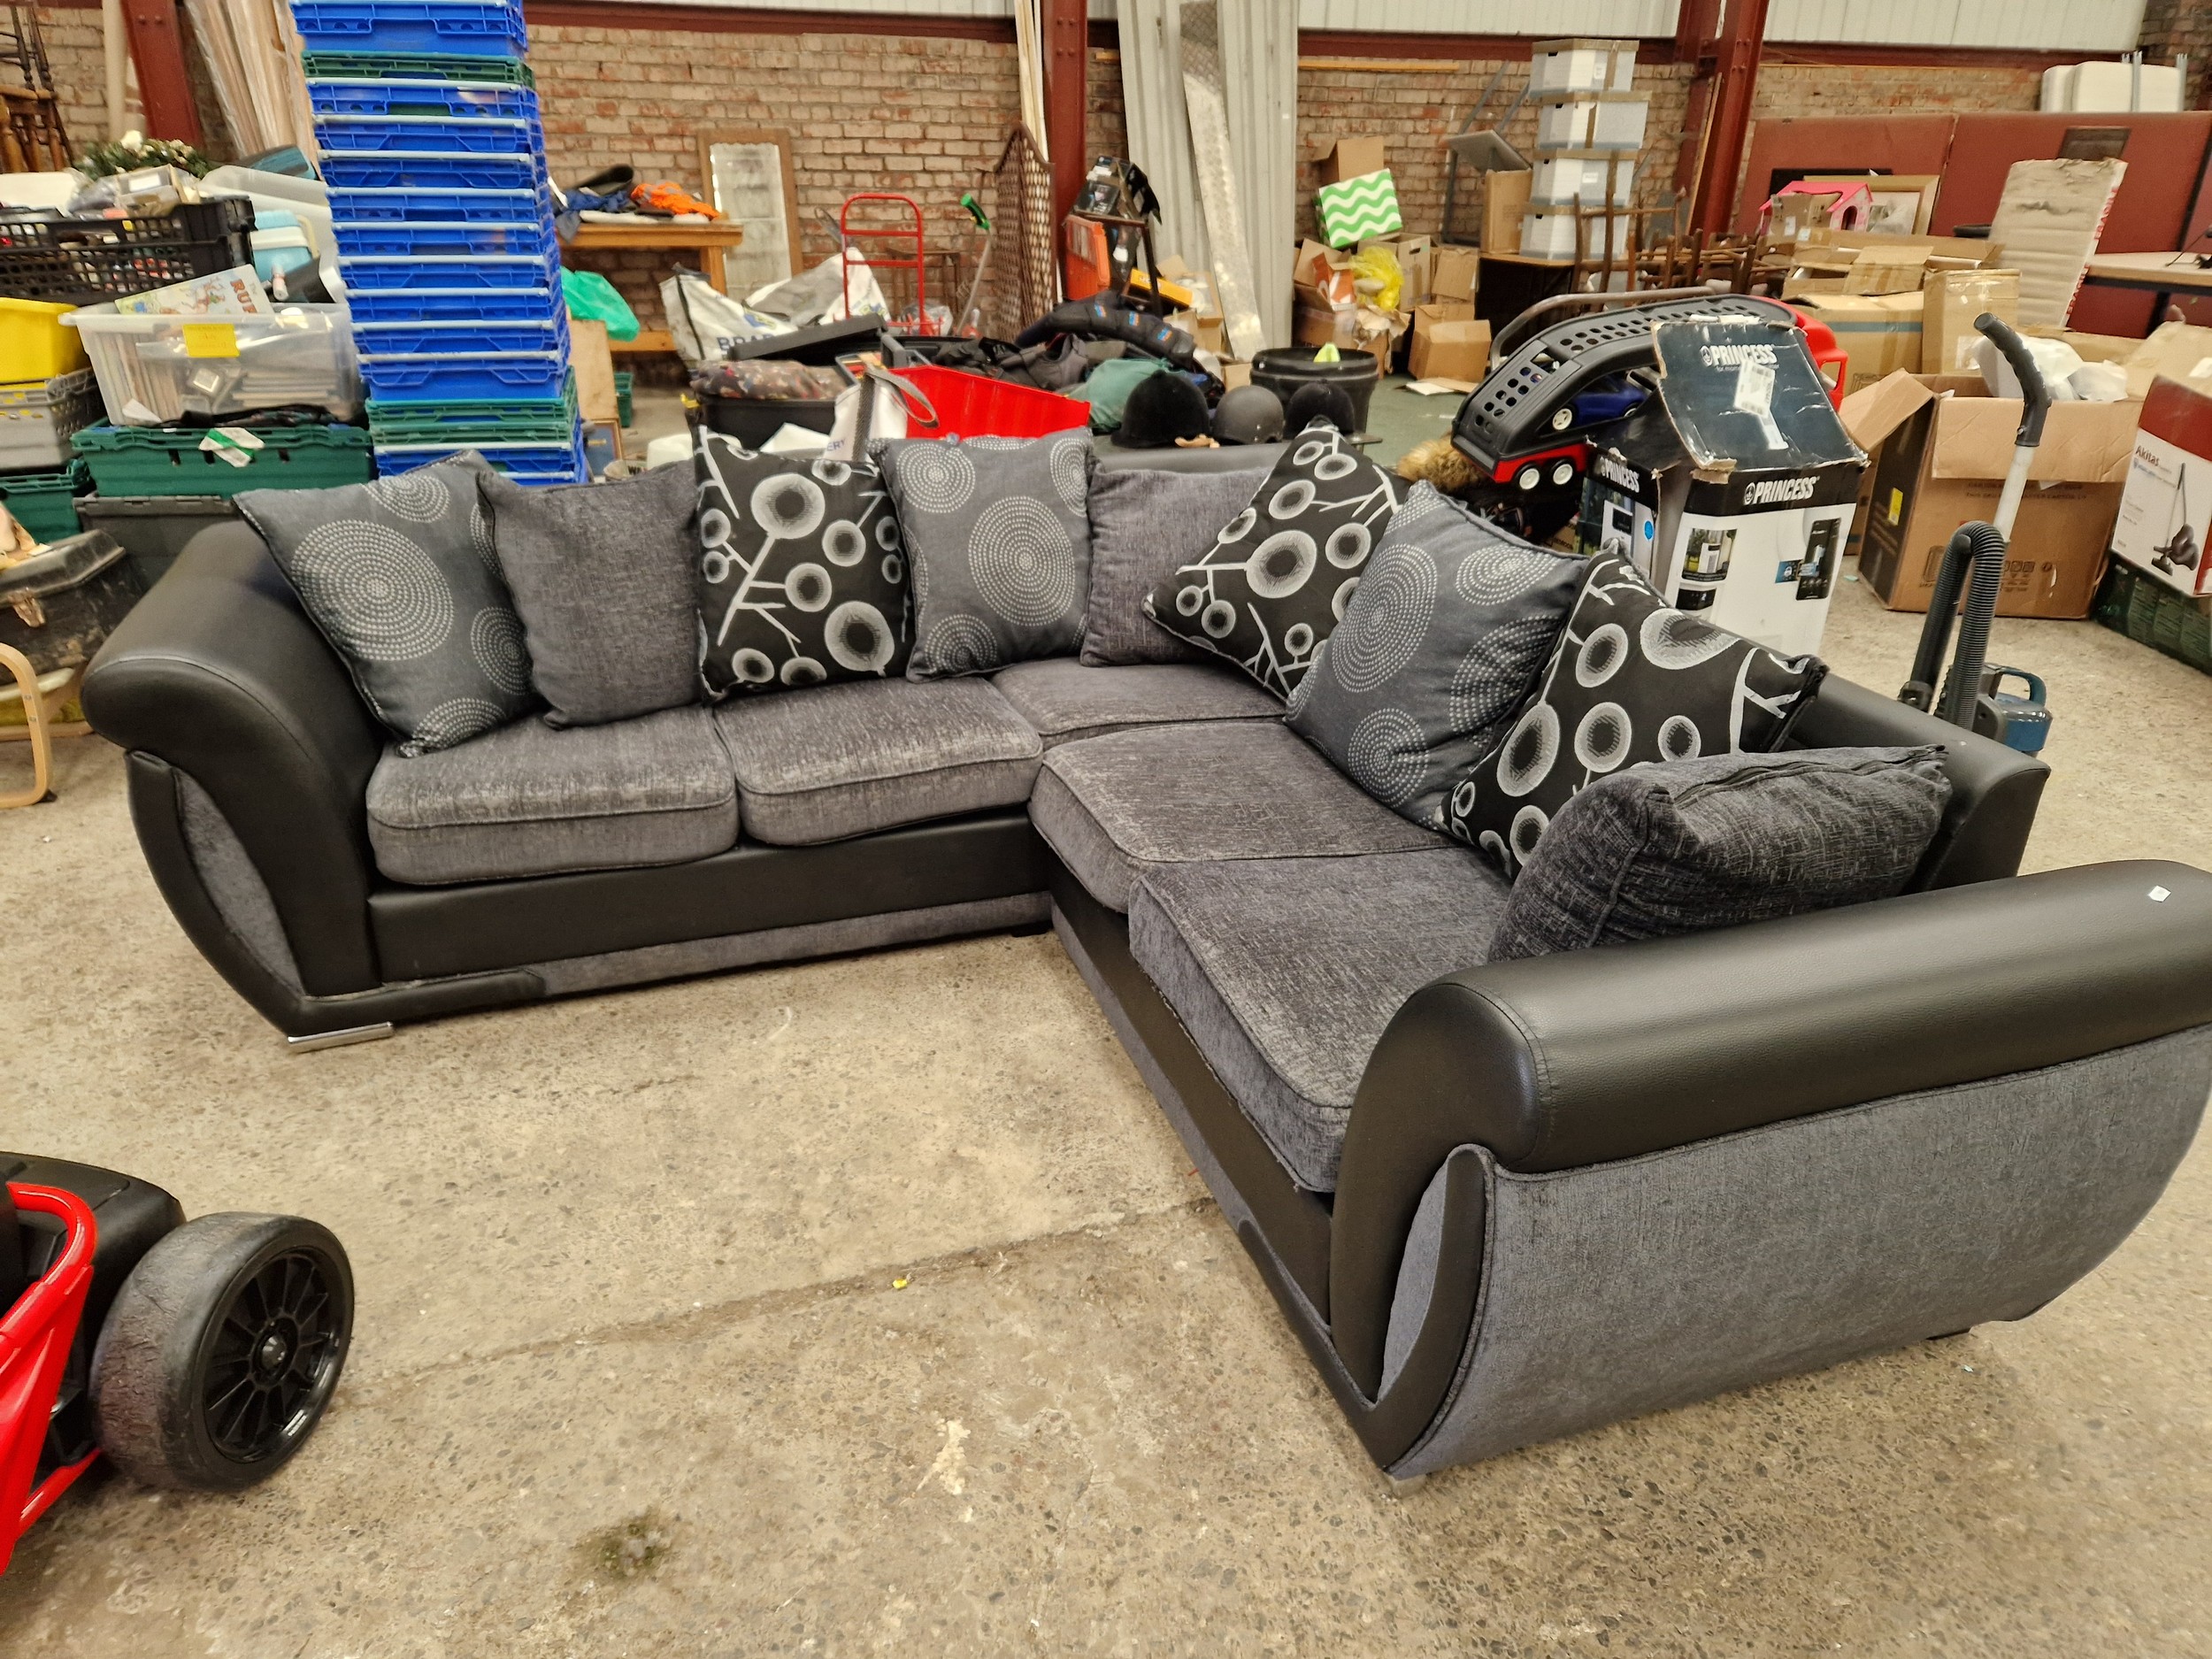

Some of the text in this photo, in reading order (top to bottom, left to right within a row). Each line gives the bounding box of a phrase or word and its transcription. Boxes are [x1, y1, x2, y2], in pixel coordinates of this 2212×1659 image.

[1709, 344, 1778, 366] PRINCESS
[2135, 444, 2161, 467] Akitas
[1604, 457, 1640, 494] PRINCESS
[1752, 476, 1816, 505] PRINCESS
